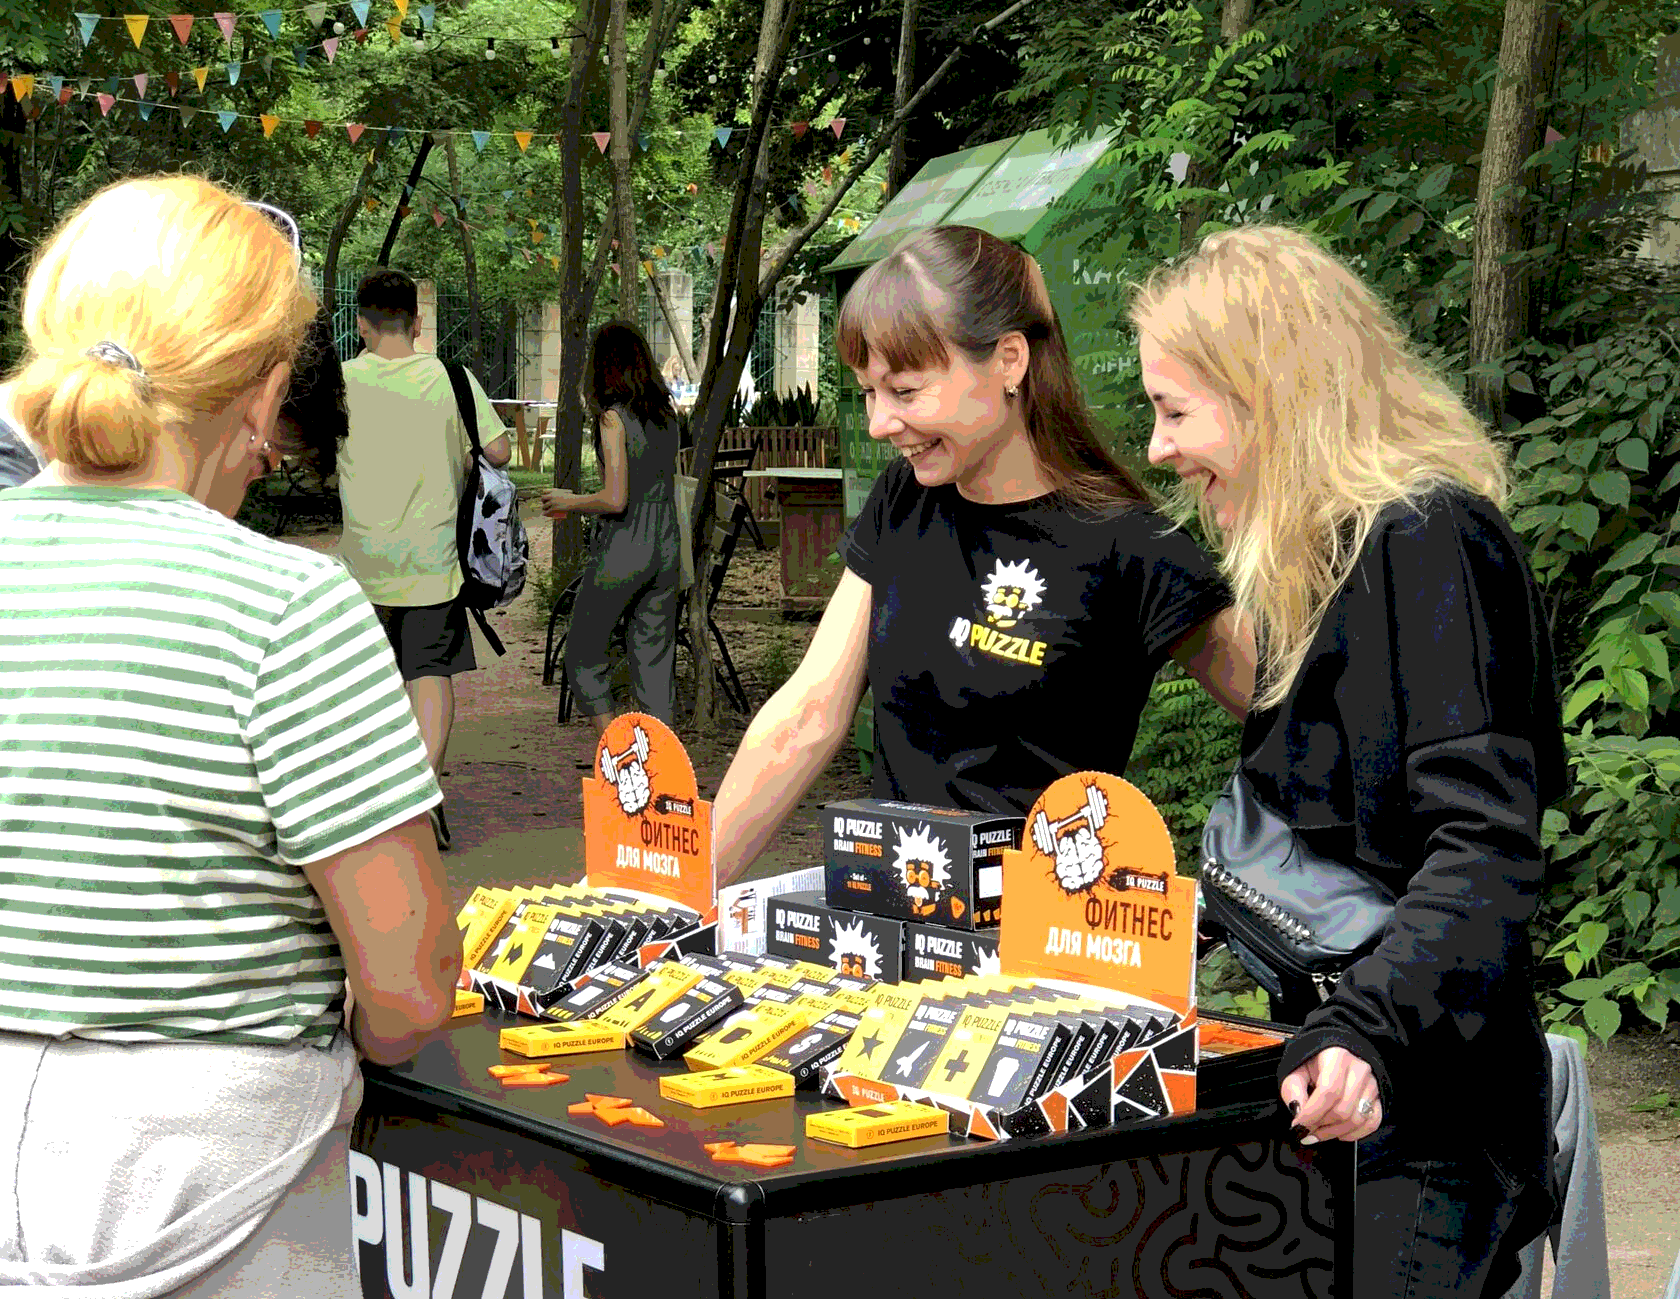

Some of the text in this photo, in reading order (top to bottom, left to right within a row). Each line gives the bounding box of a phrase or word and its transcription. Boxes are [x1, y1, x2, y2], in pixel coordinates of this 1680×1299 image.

[949, 617, 1047, 666] IQ PUZZLE
[640, 819, 699, 856] ФИТНЕС
[834, 816, 883, 839] IQ PUZZLE
[980, 829, 1012, 845] PUZZLE
[834, 838, 883, 857] BRAIN FITNESS
[616, 843, 680, 878] ДЛЯ МОЗГА
[1126, 875, 1165, 892] IQ PUZZLE
[775, 908, 820, 933] IQ PUZZLE
[1085, 897, 1173, 941] ФИТНЕС
[474, 932, 491, 955] PUZZLE
[595, 932, 614, 958] EUROPE
[618, 930, 637, 956] EUROPE
[775, 930, 820, 950] BRAIN FITNESS
[915, 933, 963, 959] IQ PUZZLE
[1044, 926, 1142, 968] ДЛЯ МОЗГА
[561, 957, 579, 981] PUZZLE
[575, 931, 593, 958] EUROPE
[915, 956, 962, 977] BRAIN FITNESS
[588, 1011, 596, 1019] IQ
[595, 996, 618, 1015] PUZZLE
[883, 995, 913, 1011] PUZZLE
[674, 996, 733, 1039] IQ PUZZLE EUROPE
[962, 1014, 1002, 1032] IQ PUZZLE
[562, 1039, 587, 1048] PUZZLE
[588, 1036, 615, 1046] EUROPE
[740, 1020, 797, 1061] IQ PUZZLE EUROPE
[1066, 1035, 1086, 1067] EUROPE
[1089, 1032, 1109, 1064] EUROPE
[810, 1061, 820, 1070] IQ
[818, 1046, 844, 1066] PUZZLE
[1029, 1068, 1047, 1097] PUZZLE
[1042, 1035, 1062, 1069] EUROPE
[731, 1089, 755, 1097] PUZZLE
[756, 1084, 784, 1094] EUROPE
[877, 1121, 939, 1137] IQ PUZZLE EUROPE
